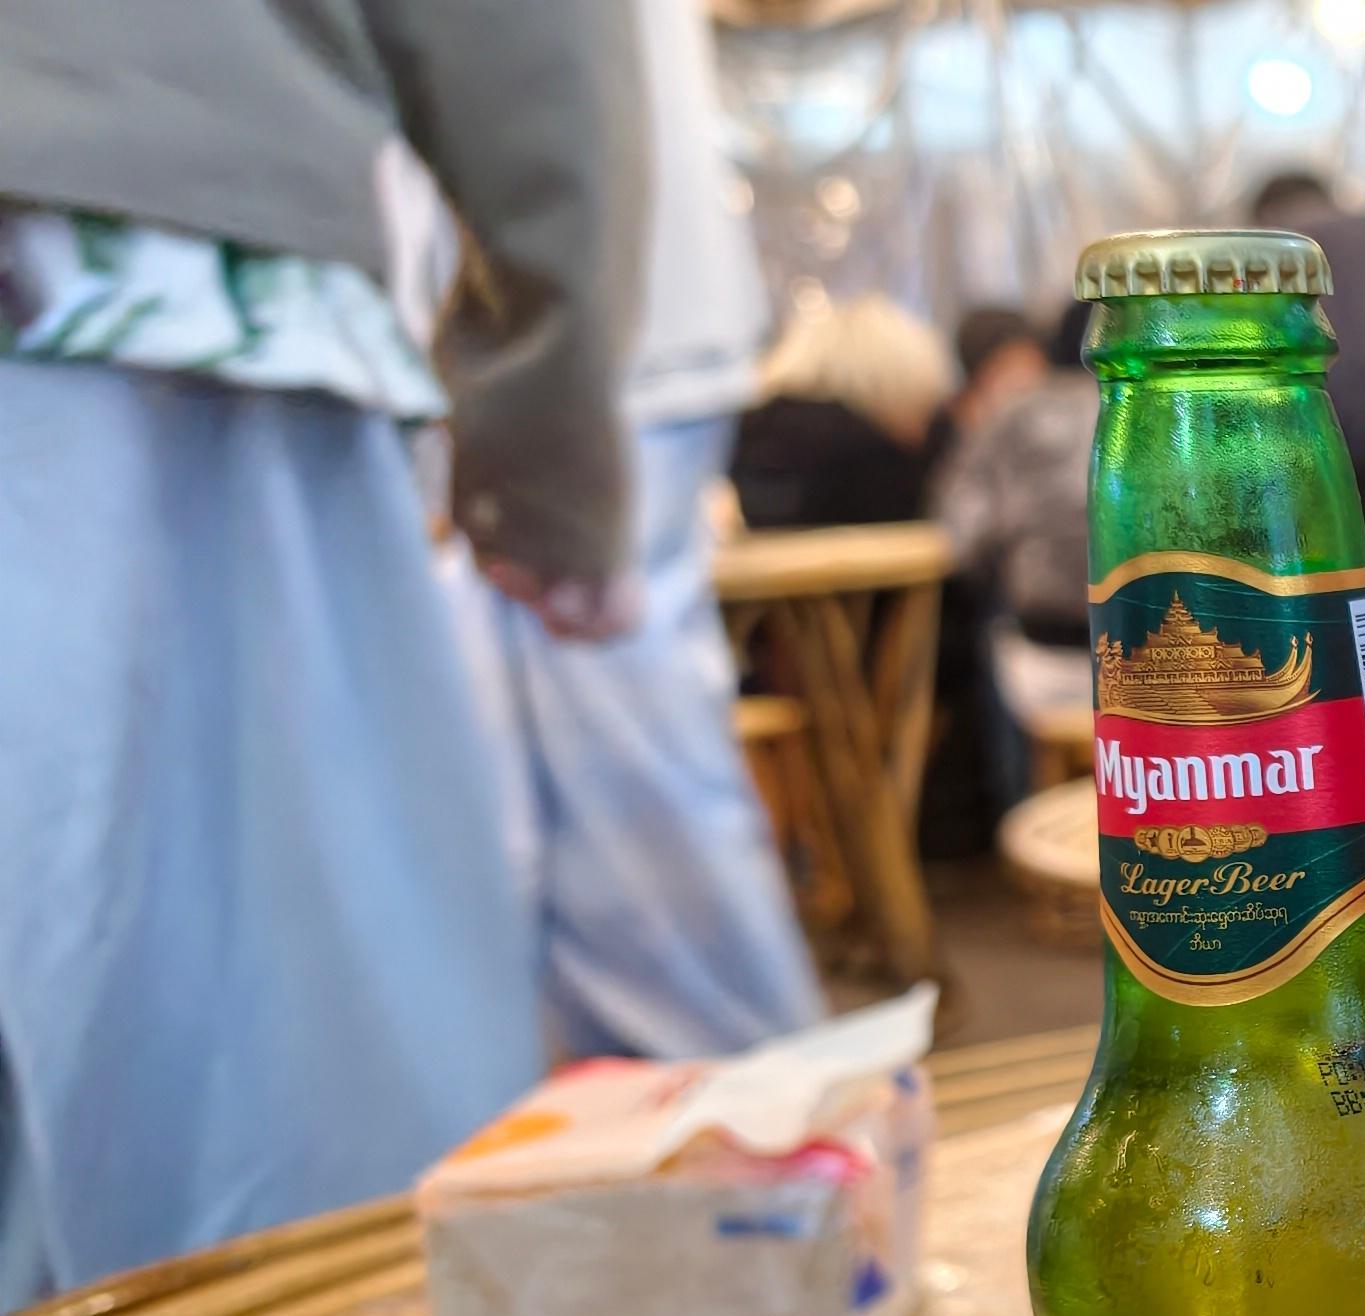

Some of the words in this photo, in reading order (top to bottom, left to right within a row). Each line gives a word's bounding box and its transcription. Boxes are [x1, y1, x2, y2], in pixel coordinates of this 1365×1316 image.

[1096, 738, 1325, 816] Myanmar
[1119, 861, 1211, 907] Lager
[1212, 859, 1306, 895] Beer
